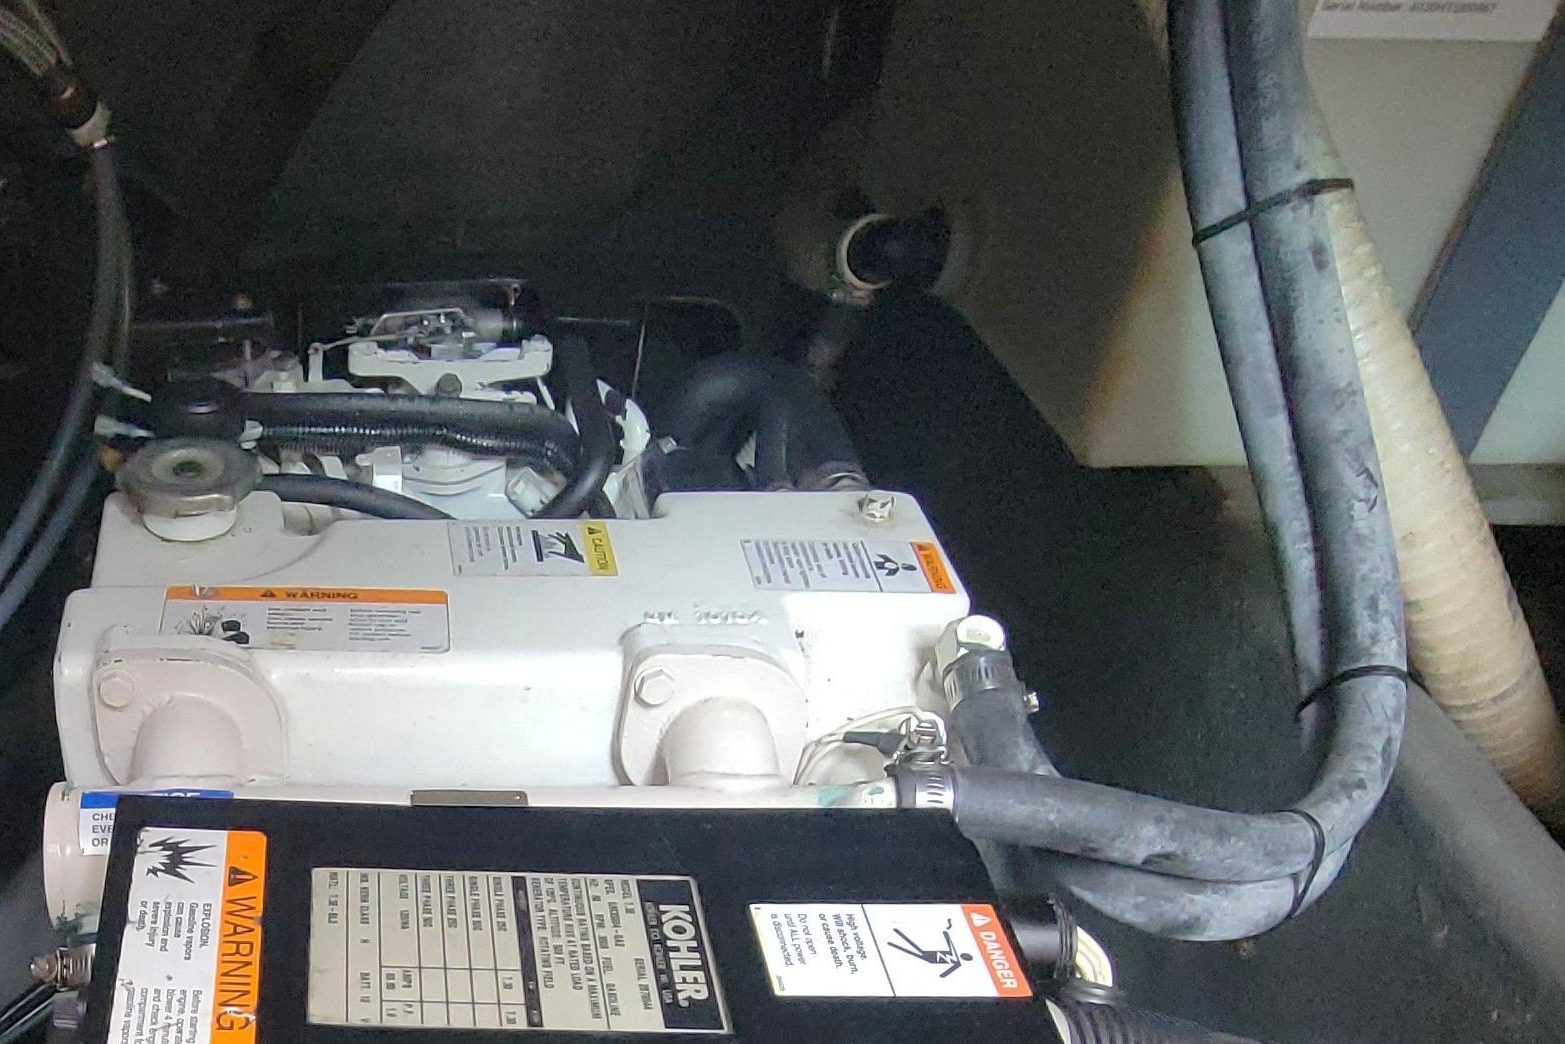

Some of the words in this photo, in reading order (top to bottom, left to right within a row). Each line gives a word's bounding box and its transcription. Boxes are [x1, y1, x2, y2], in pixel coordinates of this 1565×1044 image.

[590, 538, 611, 571] CAUTION
[284, 590, 359, 600] WARNING
[92, 813, 115, 822] CHE
[92, 825, 113, 834] EVE
[91, 837, 109, 847] OR
[140, 900, 147, 908] or
[421, 895, 432, 914] PHASE
[445, 896, 456, 914] PHASE
[530, 877, 544, 912] GENERATOR
[556, 878, 572, 921] TEMPERATURE
[149, 901, 160, 924] severe
[185, 902, 198, 933] Gasoline
[470, 898, 481, 917] PHASE
[494, 899, 505, 918] PHASE
[797, 914, 808, 922] Do
[159, 901, 173, 936] explosion
[198, 903, 211, 948] EXPLOSION.
[576, 918, 589, 940] RATING
[783, 914, 796, 927] until
[831, 913, 844, 926] Will
[843, 914, 859, 929] High
[145, 926, 158, 947] injury
[788, 929, 801, 941] ALL
[801, 925, 811, 934] not
[821, 923, 834, 944] cause
[159, 938, 169, 951] and
[182, 935, 194, 960] vapors
[538, 936, 551, 967] ROTATING
[580, 943, 593, 964] BASED
[791, 943, 806, 964] power
[803, 938, 817, 954] open
[216, 895, 257, 1031] WARNING
[554, 956, 564, 964] FT
[567, 950, 579, 970] RATED
[584, 966, 595, 975] ON
[633, 958, 648, 980] SERIAL
[980, 931, 1018, 989] DANGER
[542, 970, 553, 988] FIELD
[570, 973, 582, 990] LOAD
[153, 988, 162, 1002] and
[164, 989, 176, 1013] blower
[191, 990, 202, 1014] Before
[586, 984, 601, 1018] MAXIMUM
[604, 983, 620, 1016] GASOLINE
[132, 988, 149, 1036] compartment
[150, 1004, 161, 1025] check
[186, 1016, 198, 1043] starting
